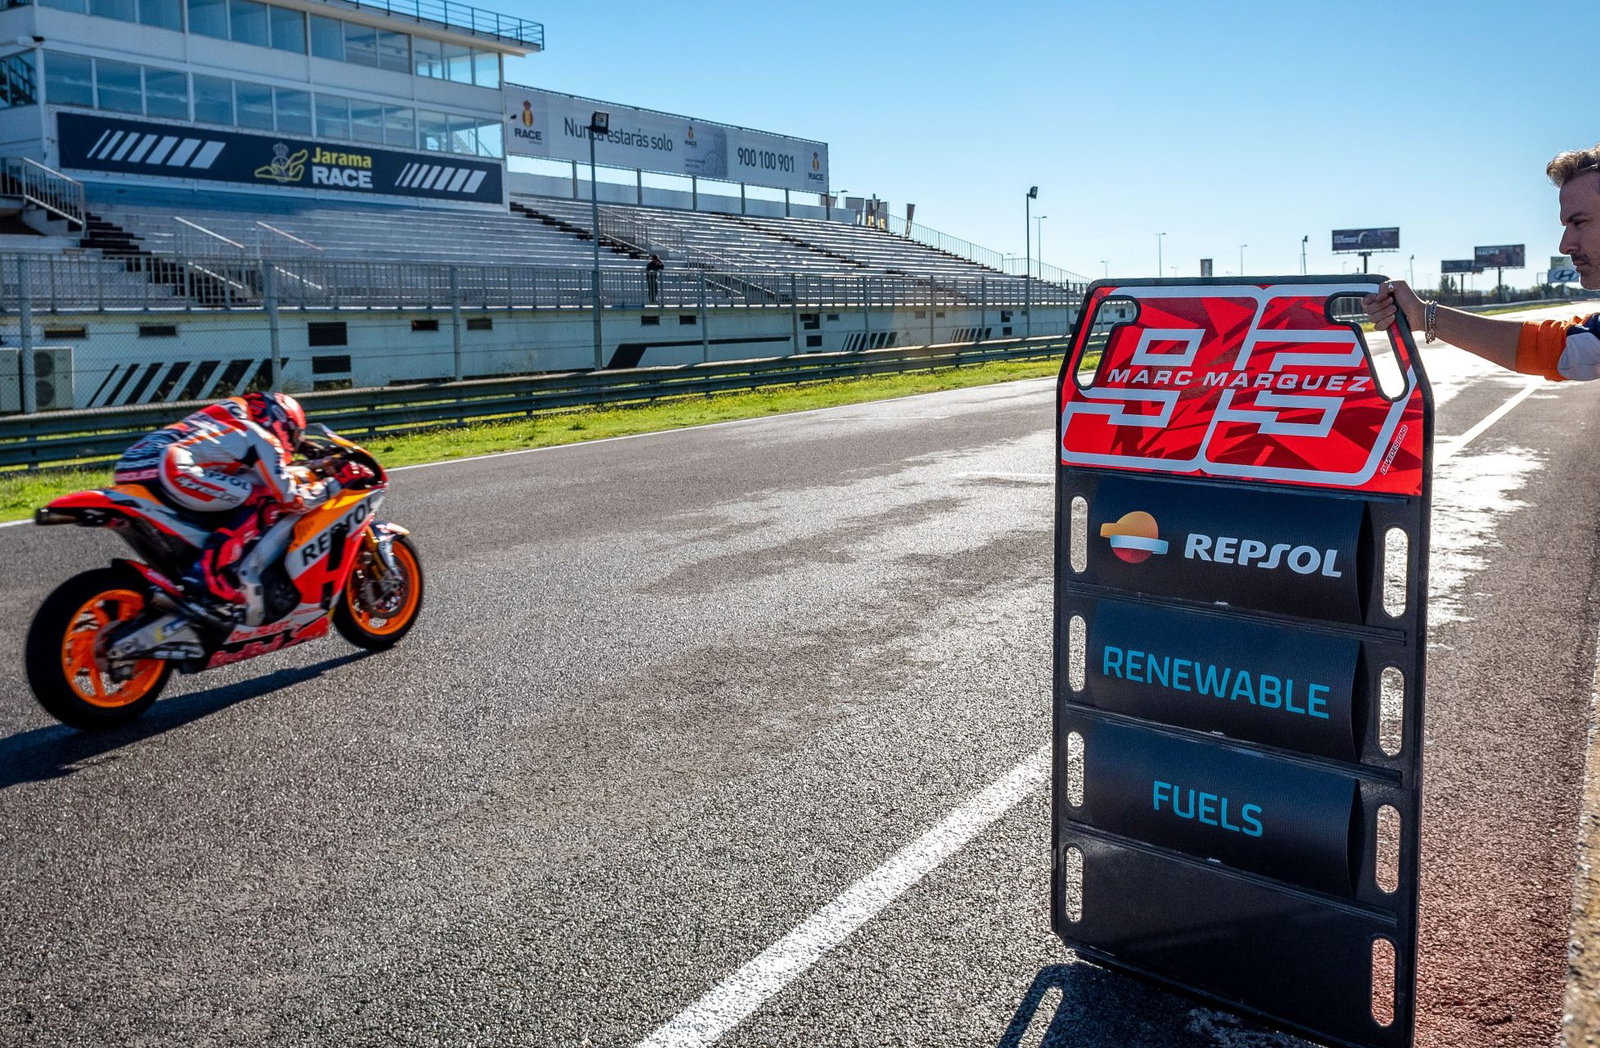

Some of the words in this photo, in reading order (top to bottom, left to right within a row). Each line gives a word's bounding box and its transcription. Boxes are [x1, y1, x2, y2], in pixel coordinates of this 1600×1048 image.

[514, 127, 542, 141] RACE
[564, 117, 605, 142] Nuna
[607, 128, 649, 148] estarás
[650, 136, 673, 152] solo
[312, 147, 372, 167] Jarama
[737, 147, 757, 167] 900
[759, 150, 776, 170] 100
[778, 154, 795, 173] 901
[312, 165, 373, 189] RACE
[808, 172, 825, 182] RACE
[1107, 368, 1194, 386] MARC
[1202, 371, 1371, 392] MARQUEZ
[1184, 533, 1342, 578] REPSOL
[1103, 646, 1330, 720] RENEWABLE
[1153, 781, 1264, 837] FUELS
